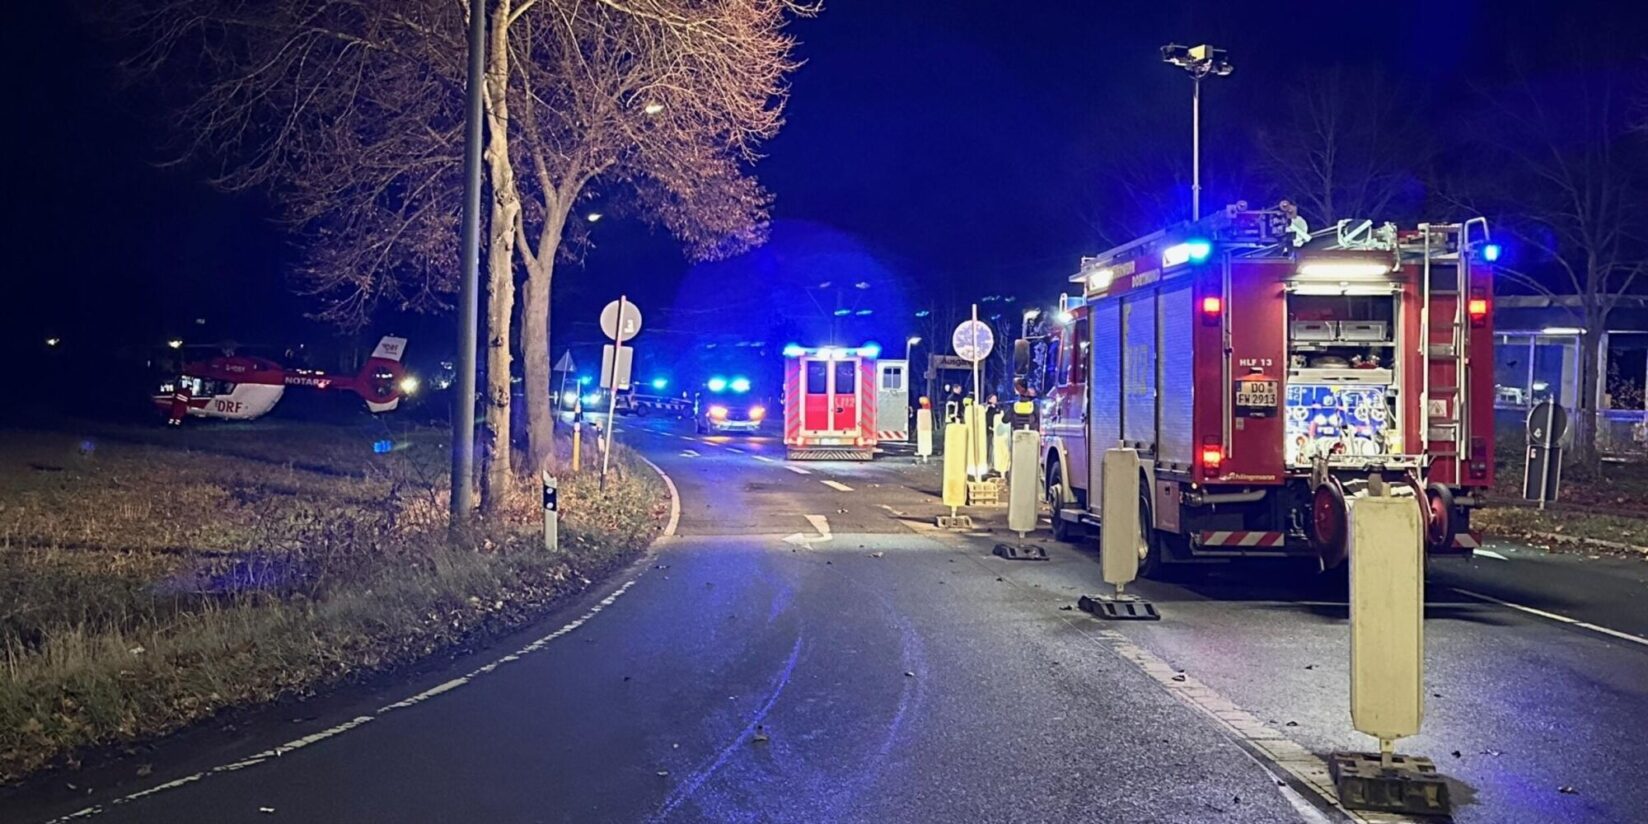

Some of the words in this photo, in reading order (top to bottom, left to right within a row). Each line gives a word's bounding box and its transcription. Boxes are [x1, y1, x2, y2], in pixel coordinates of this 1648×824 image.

[1239, 358, 1257, 367] HLF
[1260, 358, 1273, 367] 13
[1251, 382, 1265, 393] DO
[1238, 393, 1250, 404] FW
[1252, 394, 1276, 404] 2913
[217, 399, 244, 414] DRF
